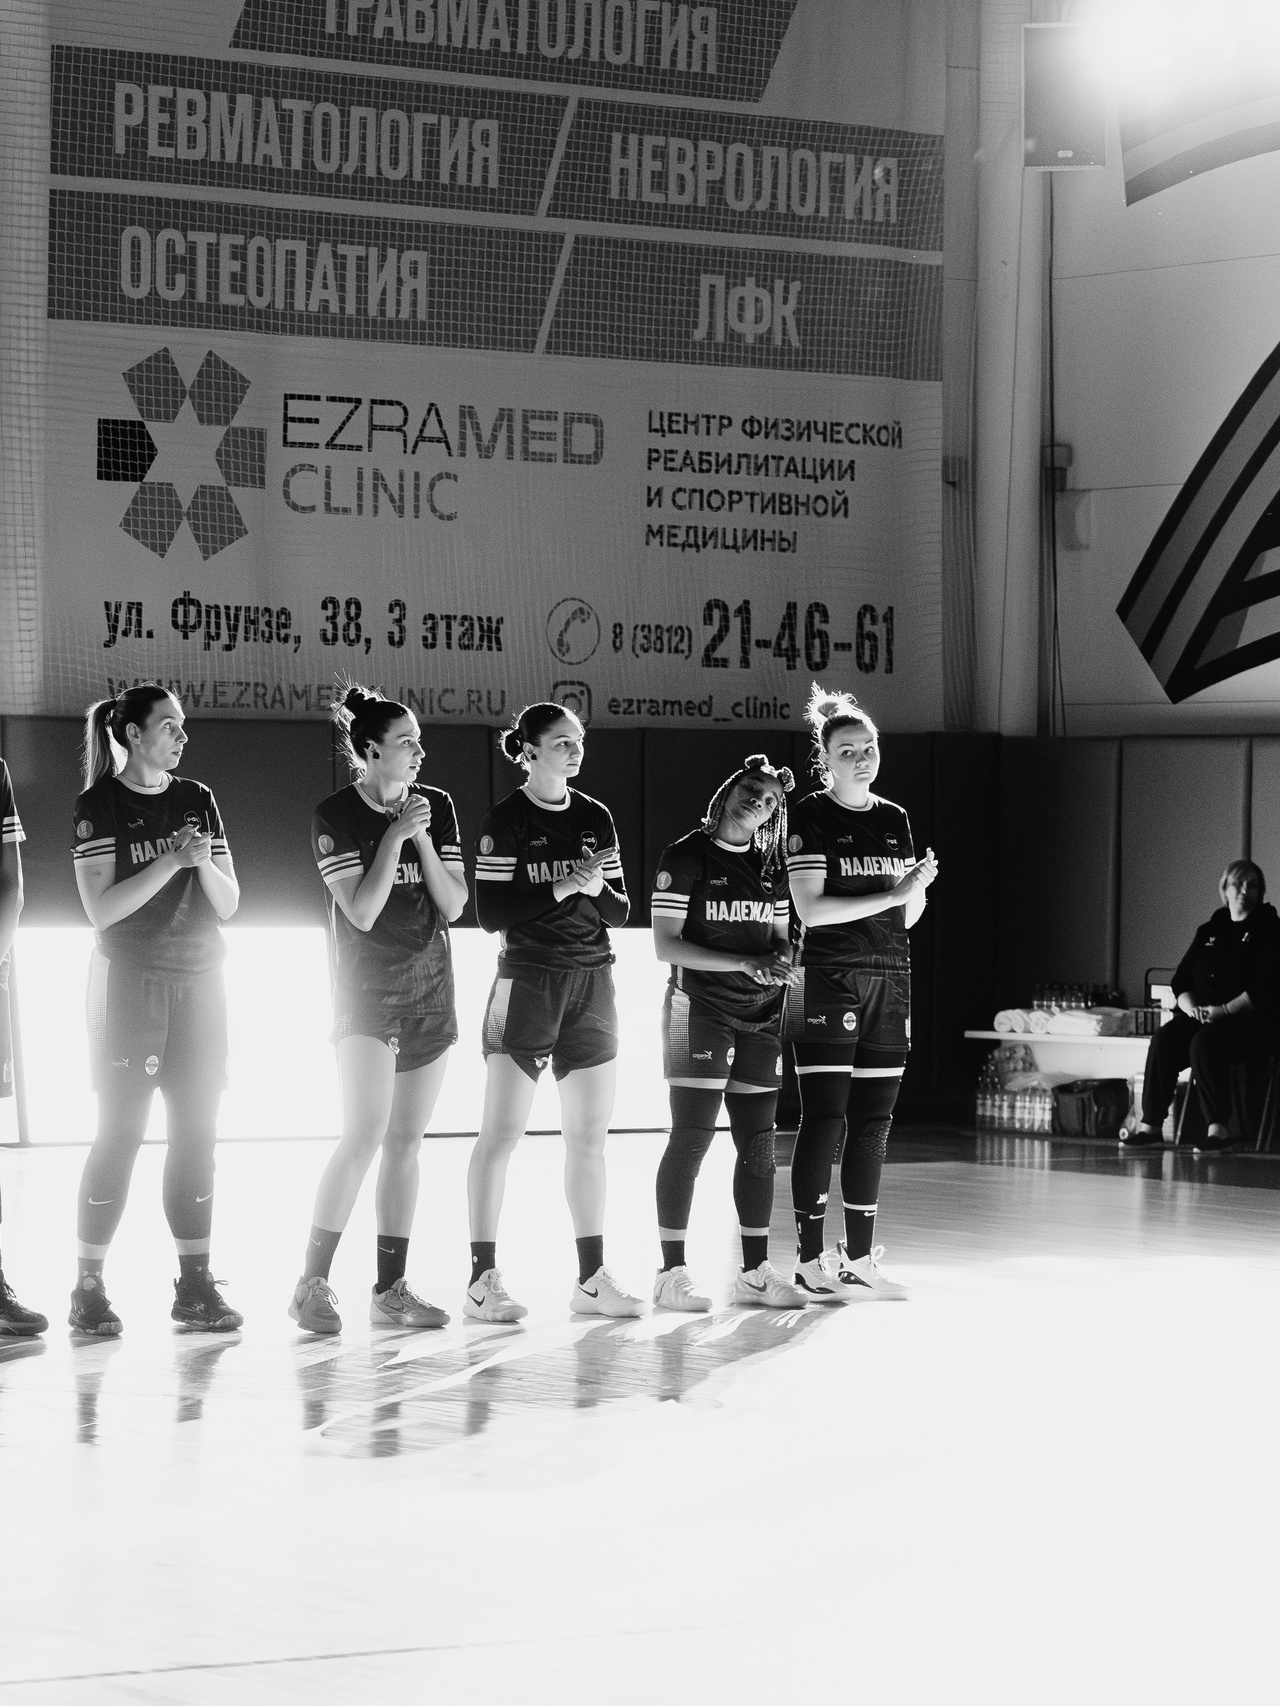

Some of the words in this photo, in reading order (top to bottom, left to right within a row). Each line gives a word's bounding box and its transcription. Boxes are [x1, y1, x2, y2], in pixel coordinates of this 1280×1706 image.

[113, 81, 499, 188] РЕВМАТОЛОГИЯ
[610, 131, 898, 225] НЕВРОЛОГИЯ
[120, 225, 428, 321] ОСТЕОПАТИЯ
[693, 274, 802, 349] ЛФК
[283, 392, 604, 466] EZRAMED
[647, 409, 733, 437] ЦЕНТР
[740, 413, 904, 450] ФИЗИЧЕСКОЙ
[282, 463, 459, 522] CLINIC
[646, 447, 856, 484] РЕАБИЛИТАЦИИ
[646, 486, 663, 509] И
[671, 487, 850, 519] СПОРТИВНОЙ
[645, 524, 799, 553] МЕДИЦИНЫ
[103, 600, 154, 649] ул.
[170, 591, 302, 653] Фрунзе,
[320, 596, 372, 654] 38,
[387, 599, 407, 649] 3
[421, 611, 504, 652] этаж
[612, 622, 624, 653] 8
[631, 623, 693, 661] (3812)
[701, 598, 895, 675] 21-46-61
[607, 694, 791, 722] ezramed_clinic
